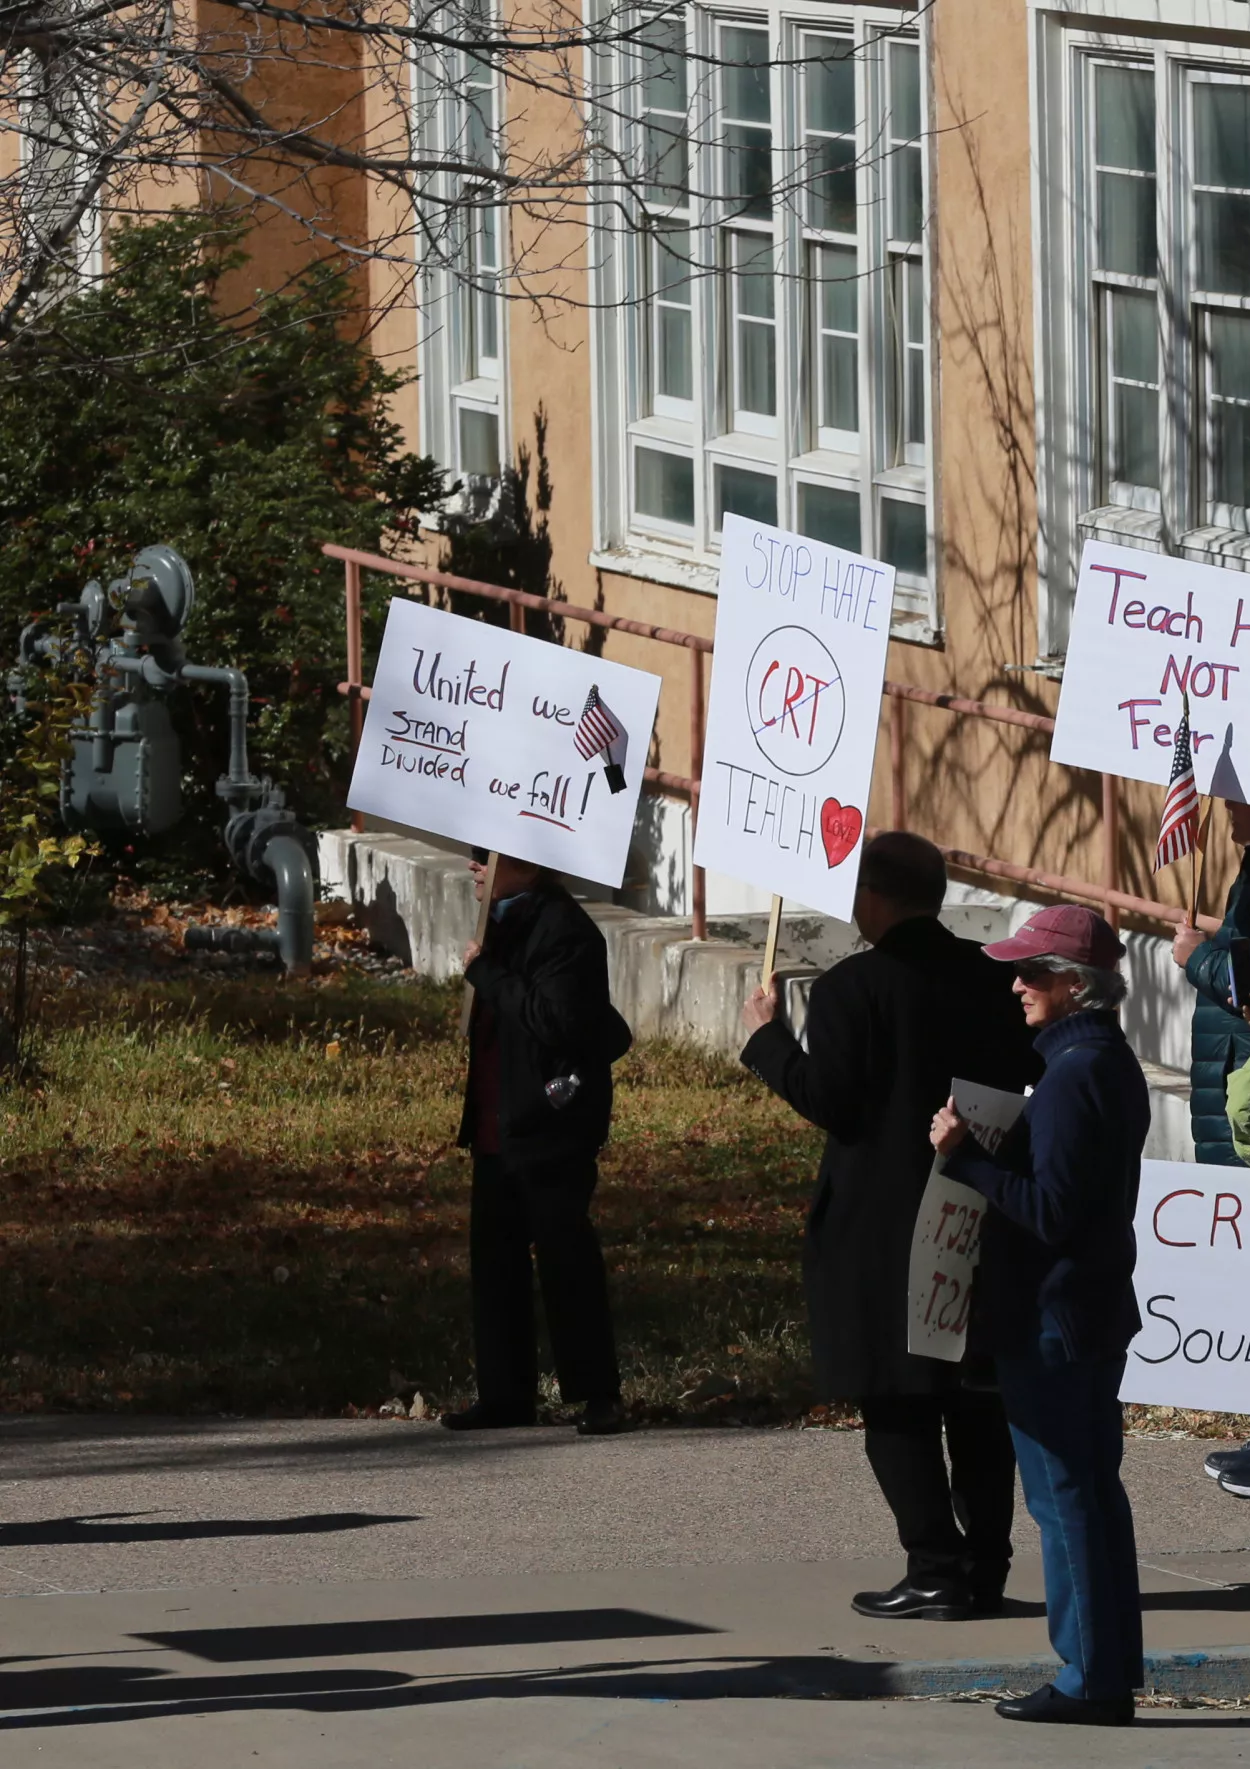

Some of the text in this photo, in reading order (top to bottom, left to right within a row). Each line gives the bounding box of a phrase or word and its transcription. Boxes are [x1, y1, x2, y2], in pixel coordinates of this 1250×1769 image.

[745, 532, 885, 631] STOP HATE
[1090, 564, 1203, 643] Teach
[413, 648, 575, 726] United we
[759, 660, 830, 746] CRT
[1160, 654, 1240, 701] NOT
[1118, 699, 1214, 754] Fer
[381, 745, 470, 787] Divided
[489, 777, 521, 799] we
[716, 761, 857, 859] TEACH LOVE
